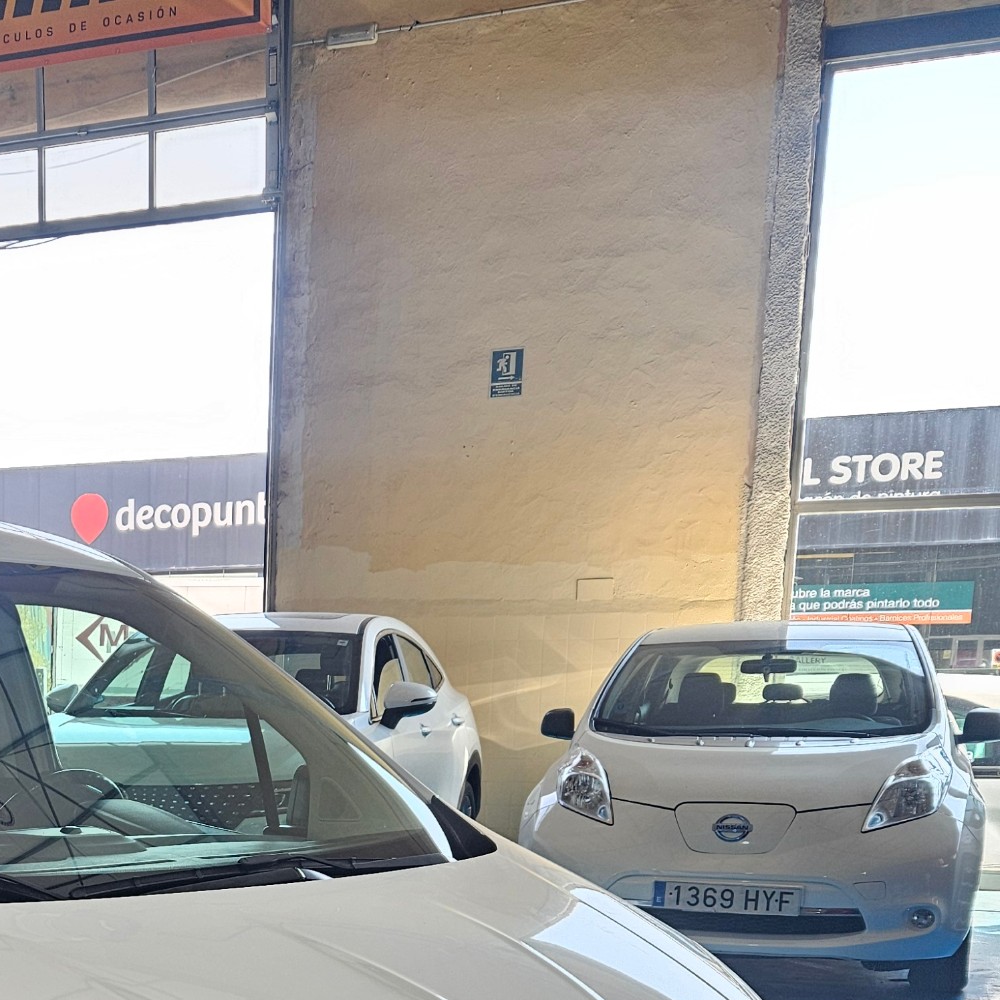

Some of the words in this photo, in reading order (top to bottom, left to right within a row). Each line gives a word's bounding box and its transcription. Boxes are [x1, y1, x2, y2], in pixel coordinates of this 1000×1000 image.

[69, 21, 87, 33] DE
[103, 6, 178, 27] OCASIÓN
[803, 457, 820, 486] L
[829, 450, 945, 484] STORE
[820, 588, 831, 598] la
[833, 588, 871, 597] marca
[798, 601, 820, 612] que
[823, 599, 864, 611] podrás
[866, 598, 911, 610] pintarlo
[914, 597, 940, 609] todo
[789, 656, 826, 664] ALLERY
[672, 885, 735, 909] 1369
[744, 889, 794, 912] HYF
